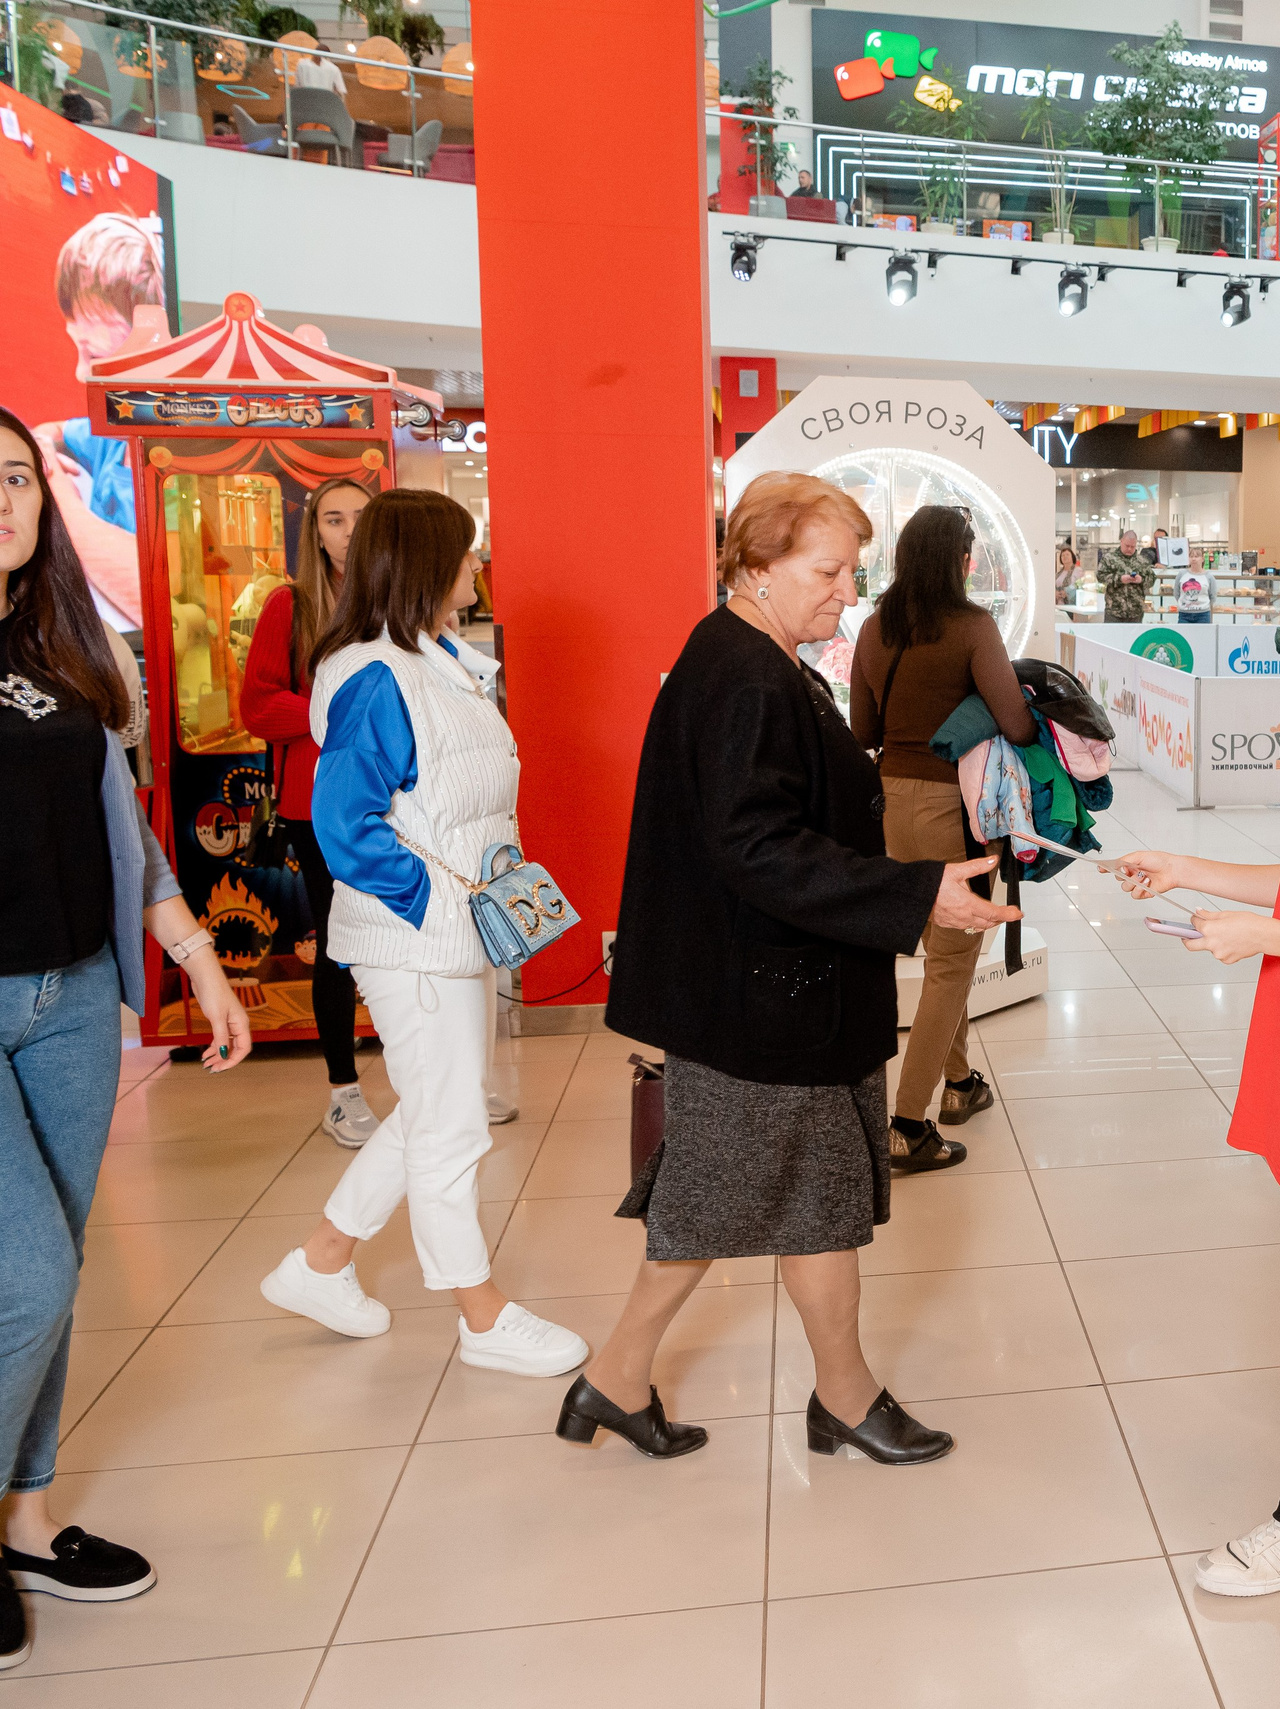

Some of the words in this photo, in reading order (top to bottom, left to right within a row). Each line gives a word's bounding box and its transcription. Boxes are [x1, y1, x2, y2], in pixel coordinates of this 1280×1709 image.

[161, 402, 212, 415] MONKEY
[226, 395, 324, 427] CIRCUS
[800, 400, 892, 440] СВОЯ
[904, 401, 985, 450] РОЗА
[1211, 763, 1274, 771] экипировочный
